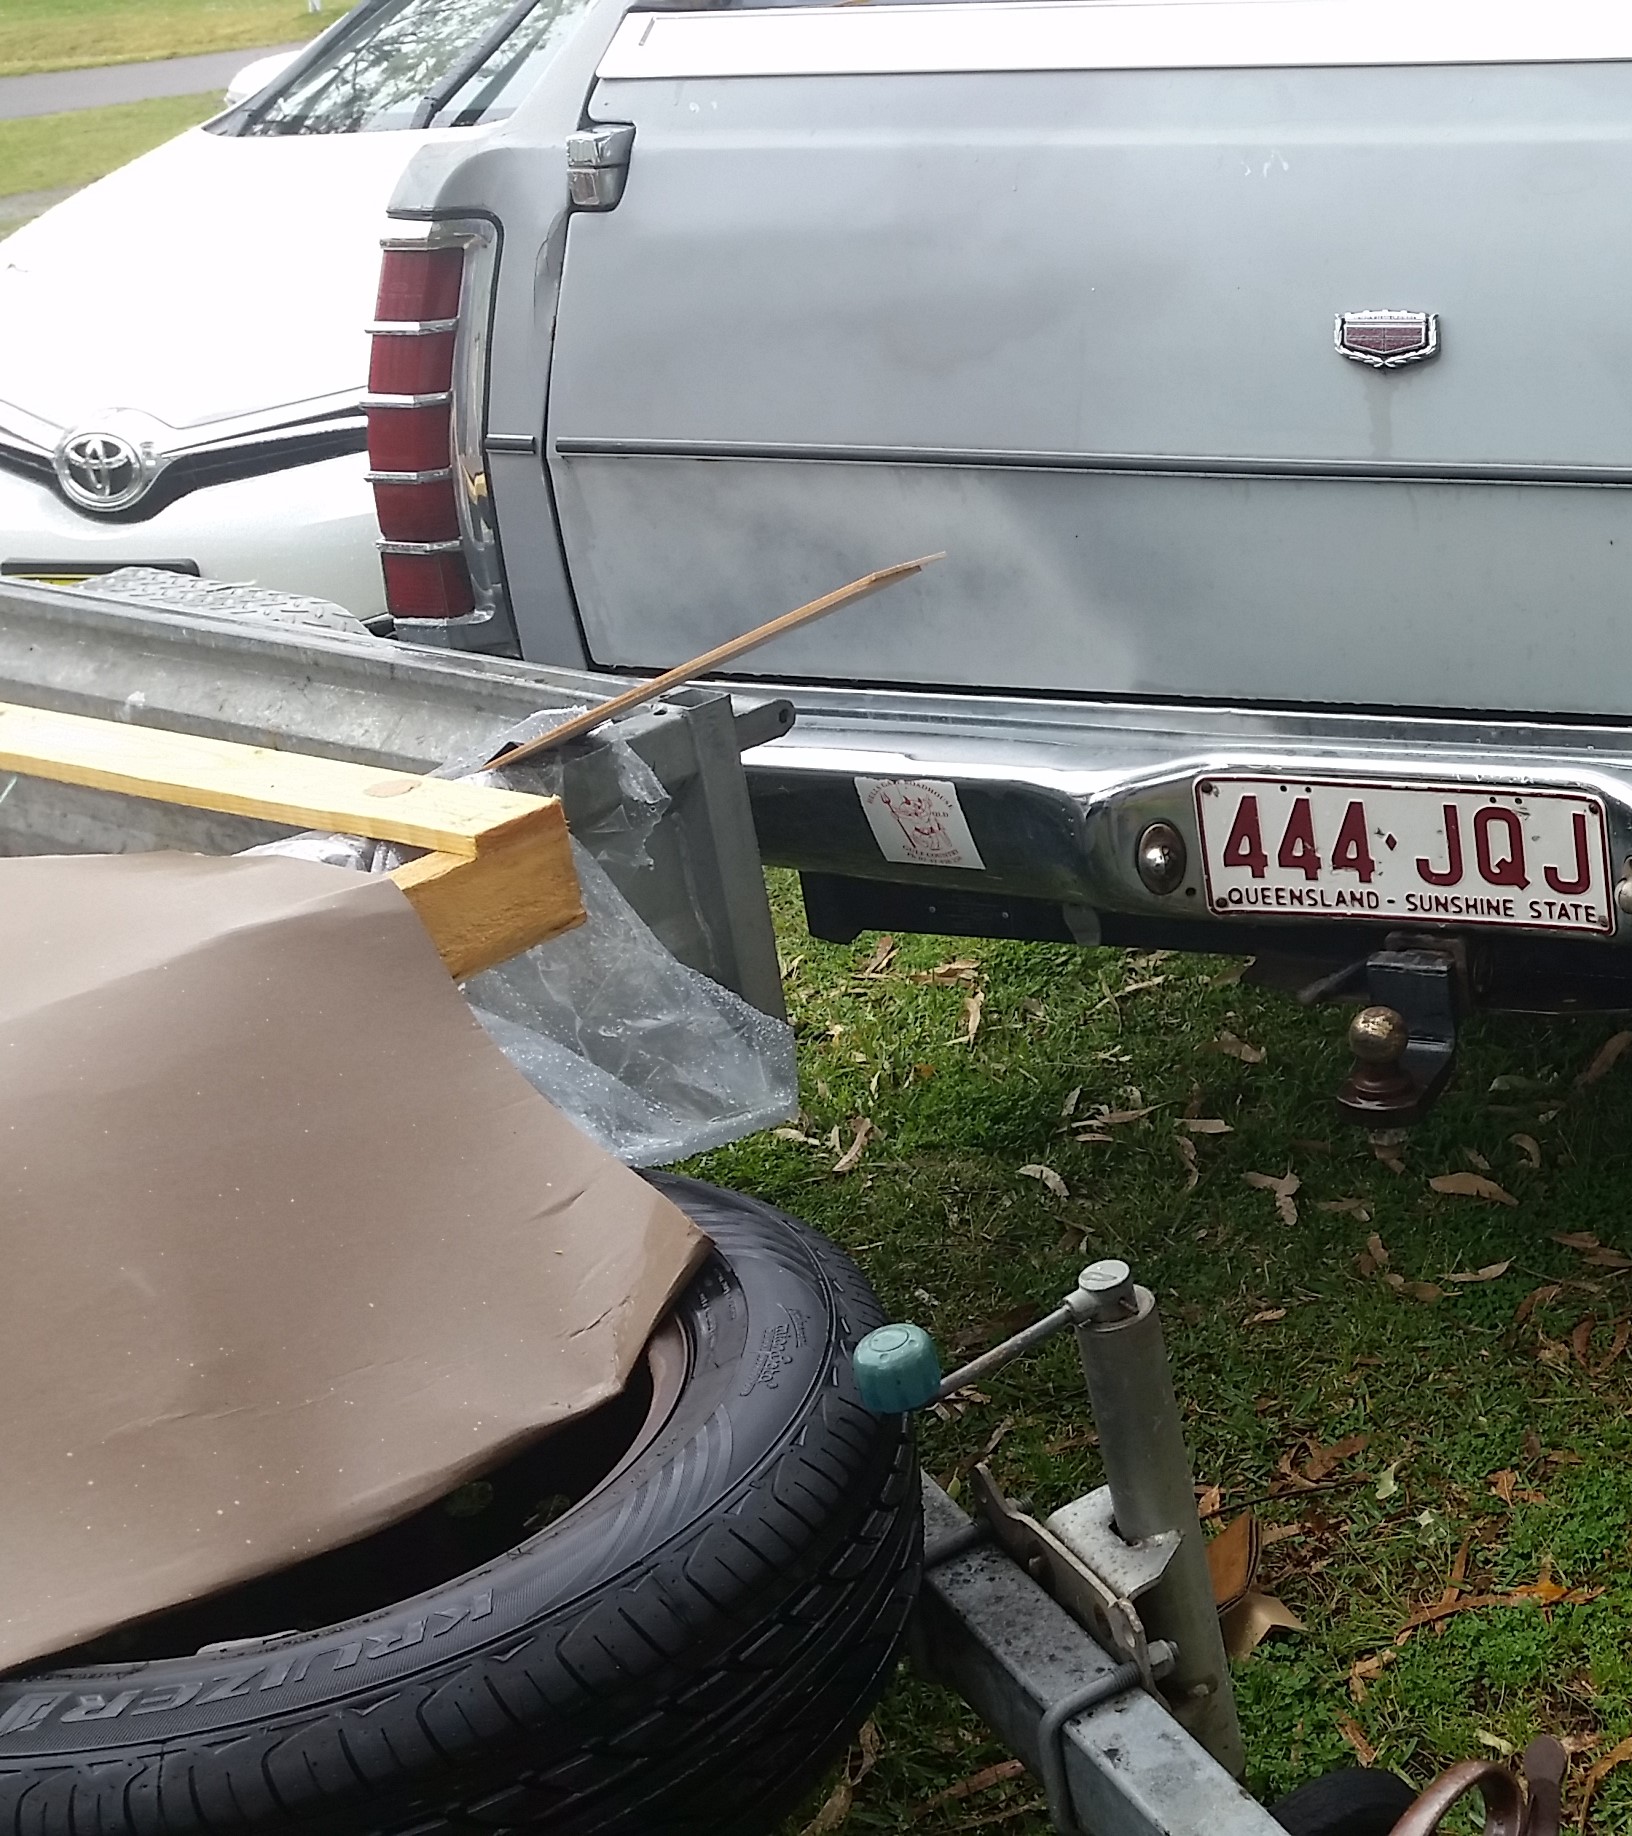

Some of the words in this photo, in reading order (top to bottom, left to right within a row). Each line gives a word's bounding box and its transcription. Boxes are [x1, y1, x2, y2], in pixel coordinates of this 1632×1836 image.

[1222, 794, 1376, 883] 444
[1415, 804, 1592, 895] JQJ
[1227, 886, 1381, 910] QUEENSLAND
[1406, 893, 1515, 918] SUNSHINE
[1529, 899, 1598, 925] STATE
